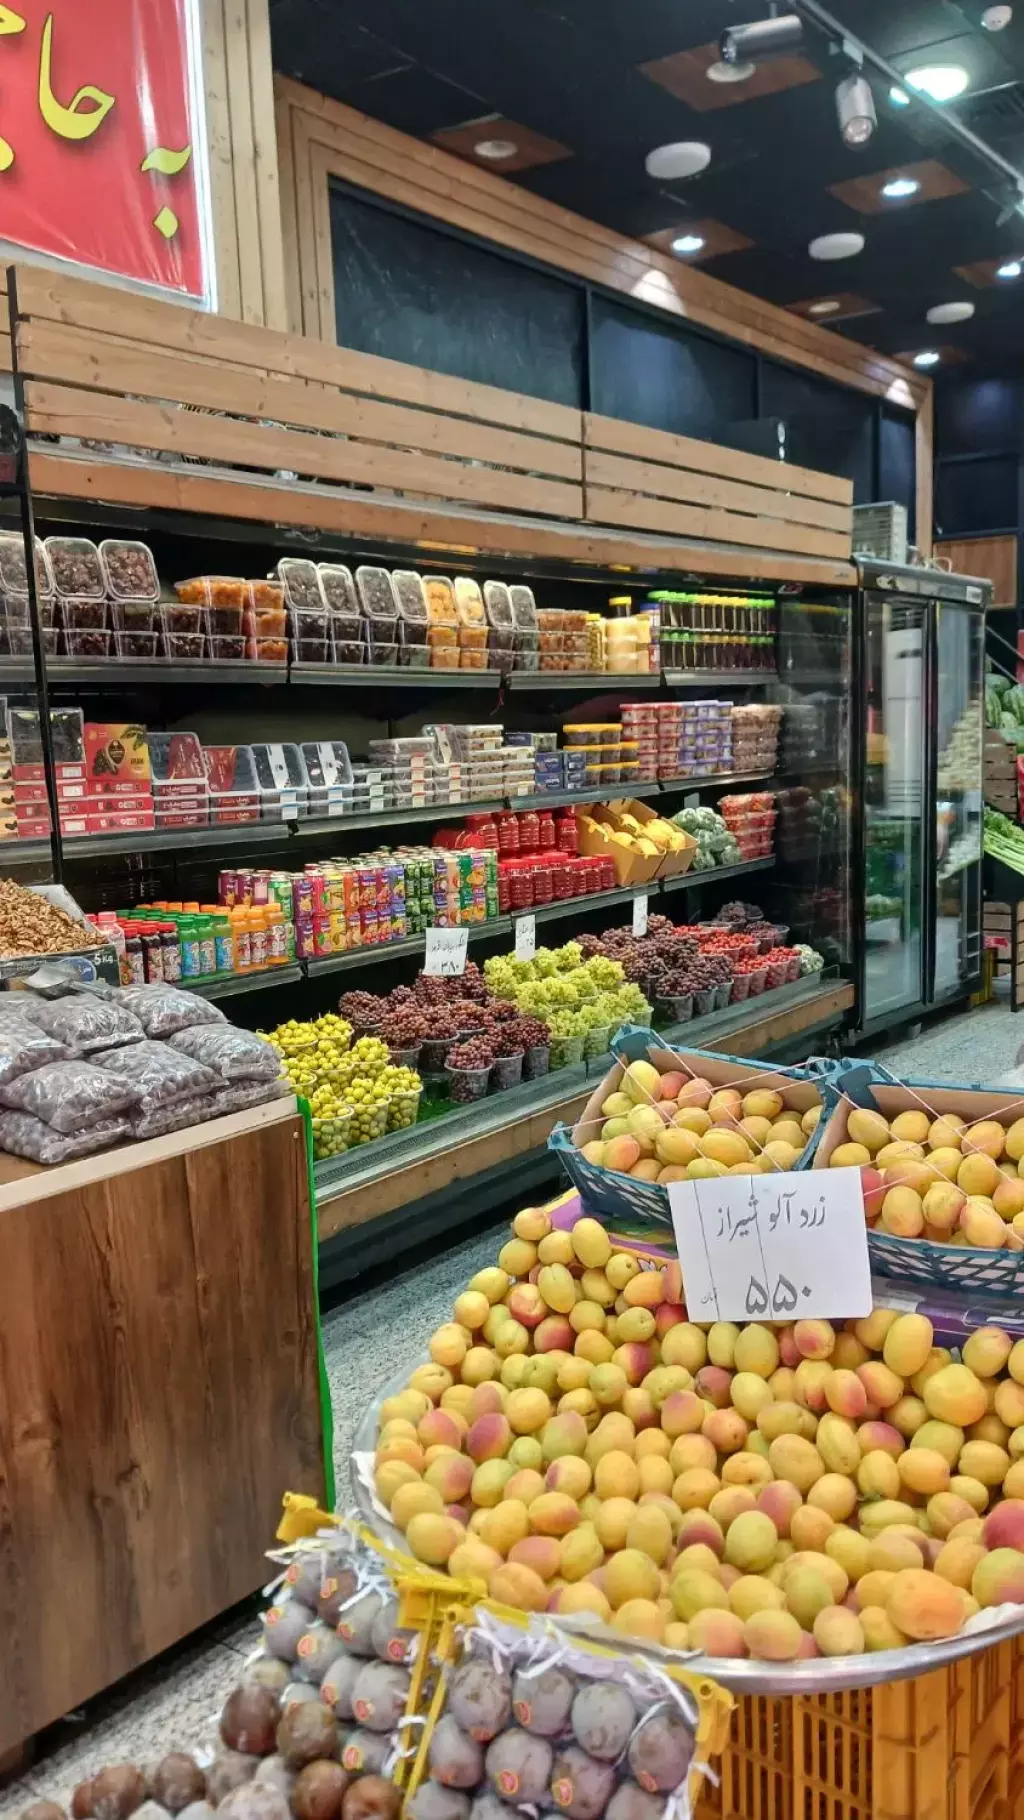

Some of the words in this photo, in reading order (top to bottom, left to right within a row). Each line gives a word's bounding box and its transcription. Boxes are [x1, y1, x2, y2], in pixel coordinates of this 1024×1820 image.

[716, 1194, 759, 1241] شیراز
[769, 1190, 797, 1231] آلو
[800, 1195, 826, 1228] زرد
[745, 1273, 812, 1314] ۵۵۰
